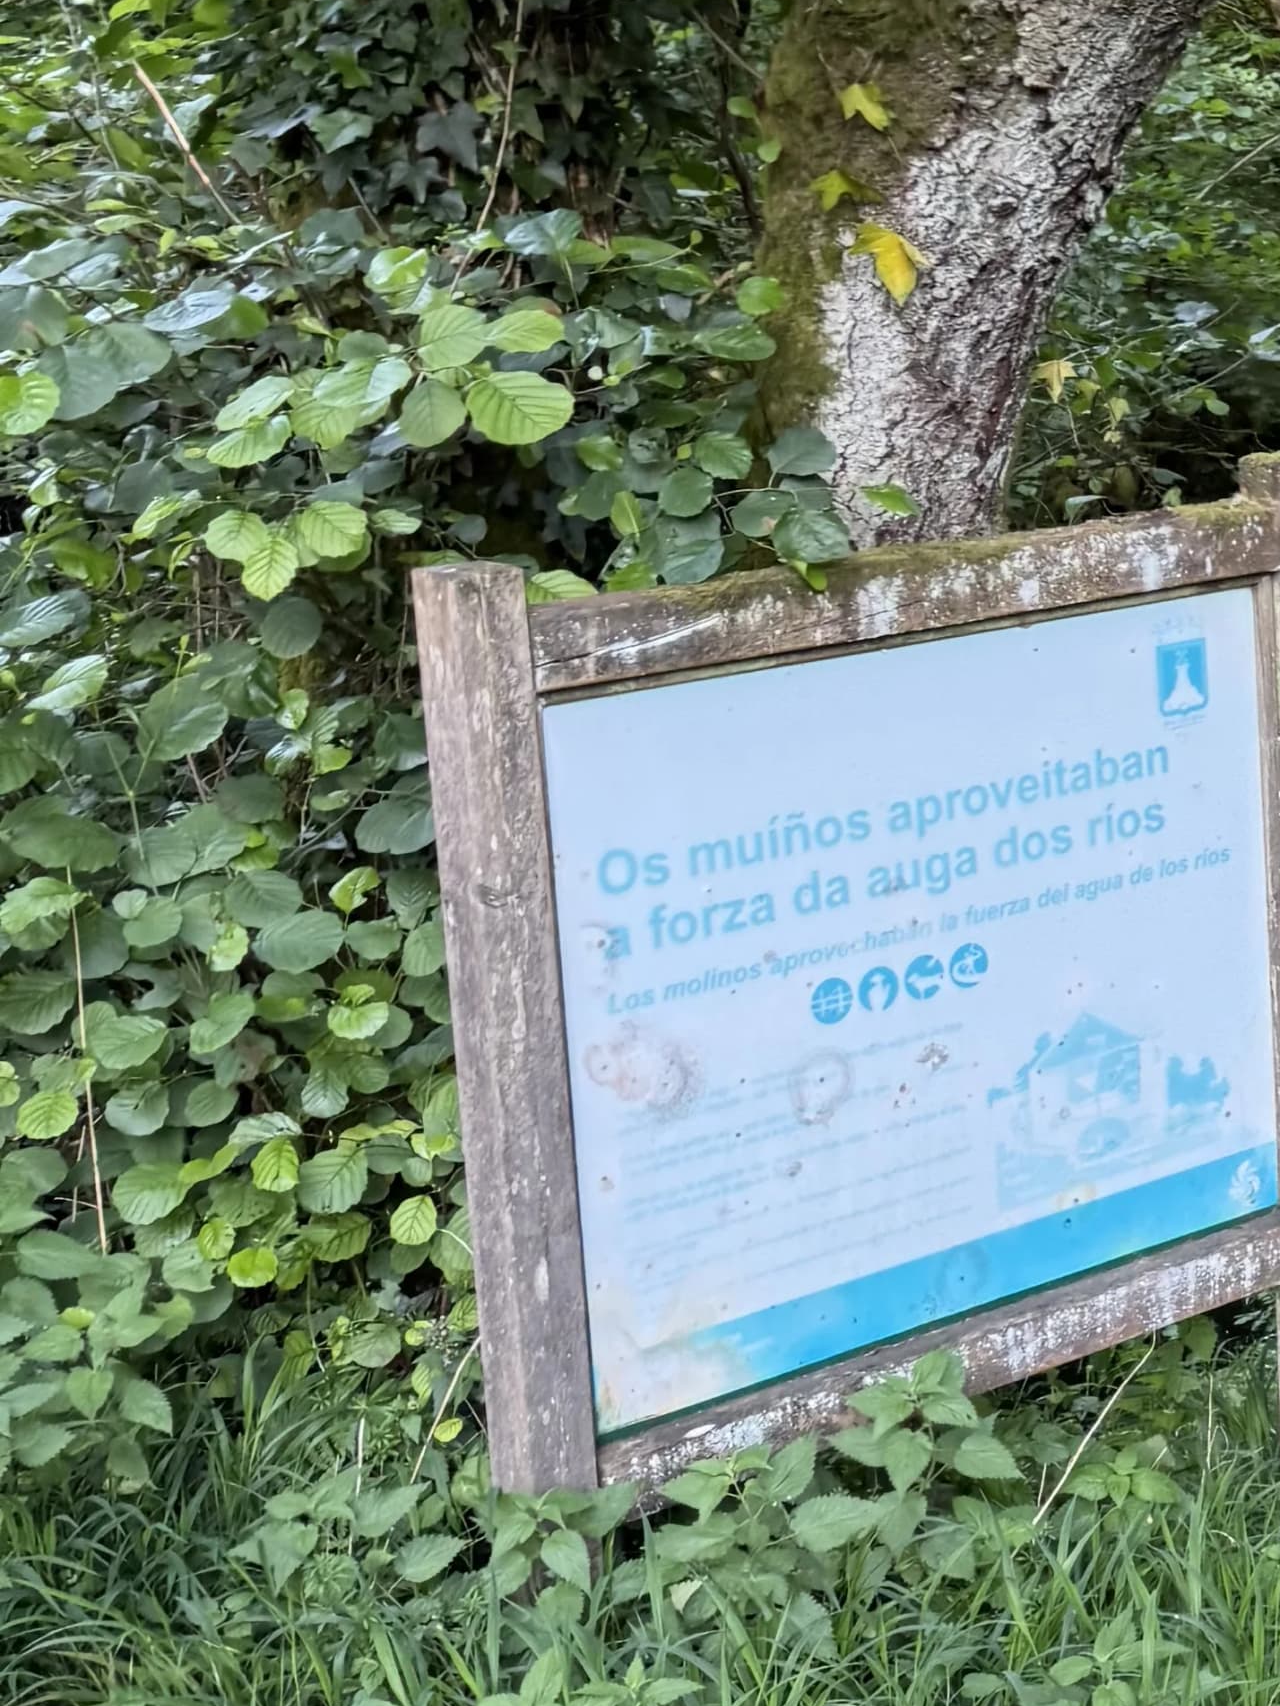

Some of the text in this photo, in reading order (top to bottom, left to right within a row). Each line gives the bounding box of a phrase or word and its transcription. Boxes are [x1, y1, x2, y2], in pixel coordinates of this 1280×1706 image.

[597, 744, 1169, 895] Os muíños aproveitaban
[604, 802, 1165, 960] a forza da auga dos ríos
[607, 989, 655, 1016] Los
[663, 963, 761, 1001] molinos
[939, 911, 958, 934] la
[964, 897, 1030, 928] fuerza
[1037, 882, 1069, 909] del
[1074, 872, 1123, 902] agua
[1129, 861, 1153, 885] de
[1159, 857, 1188, 879] los
[1193, 845, 1231, 872] ríos
